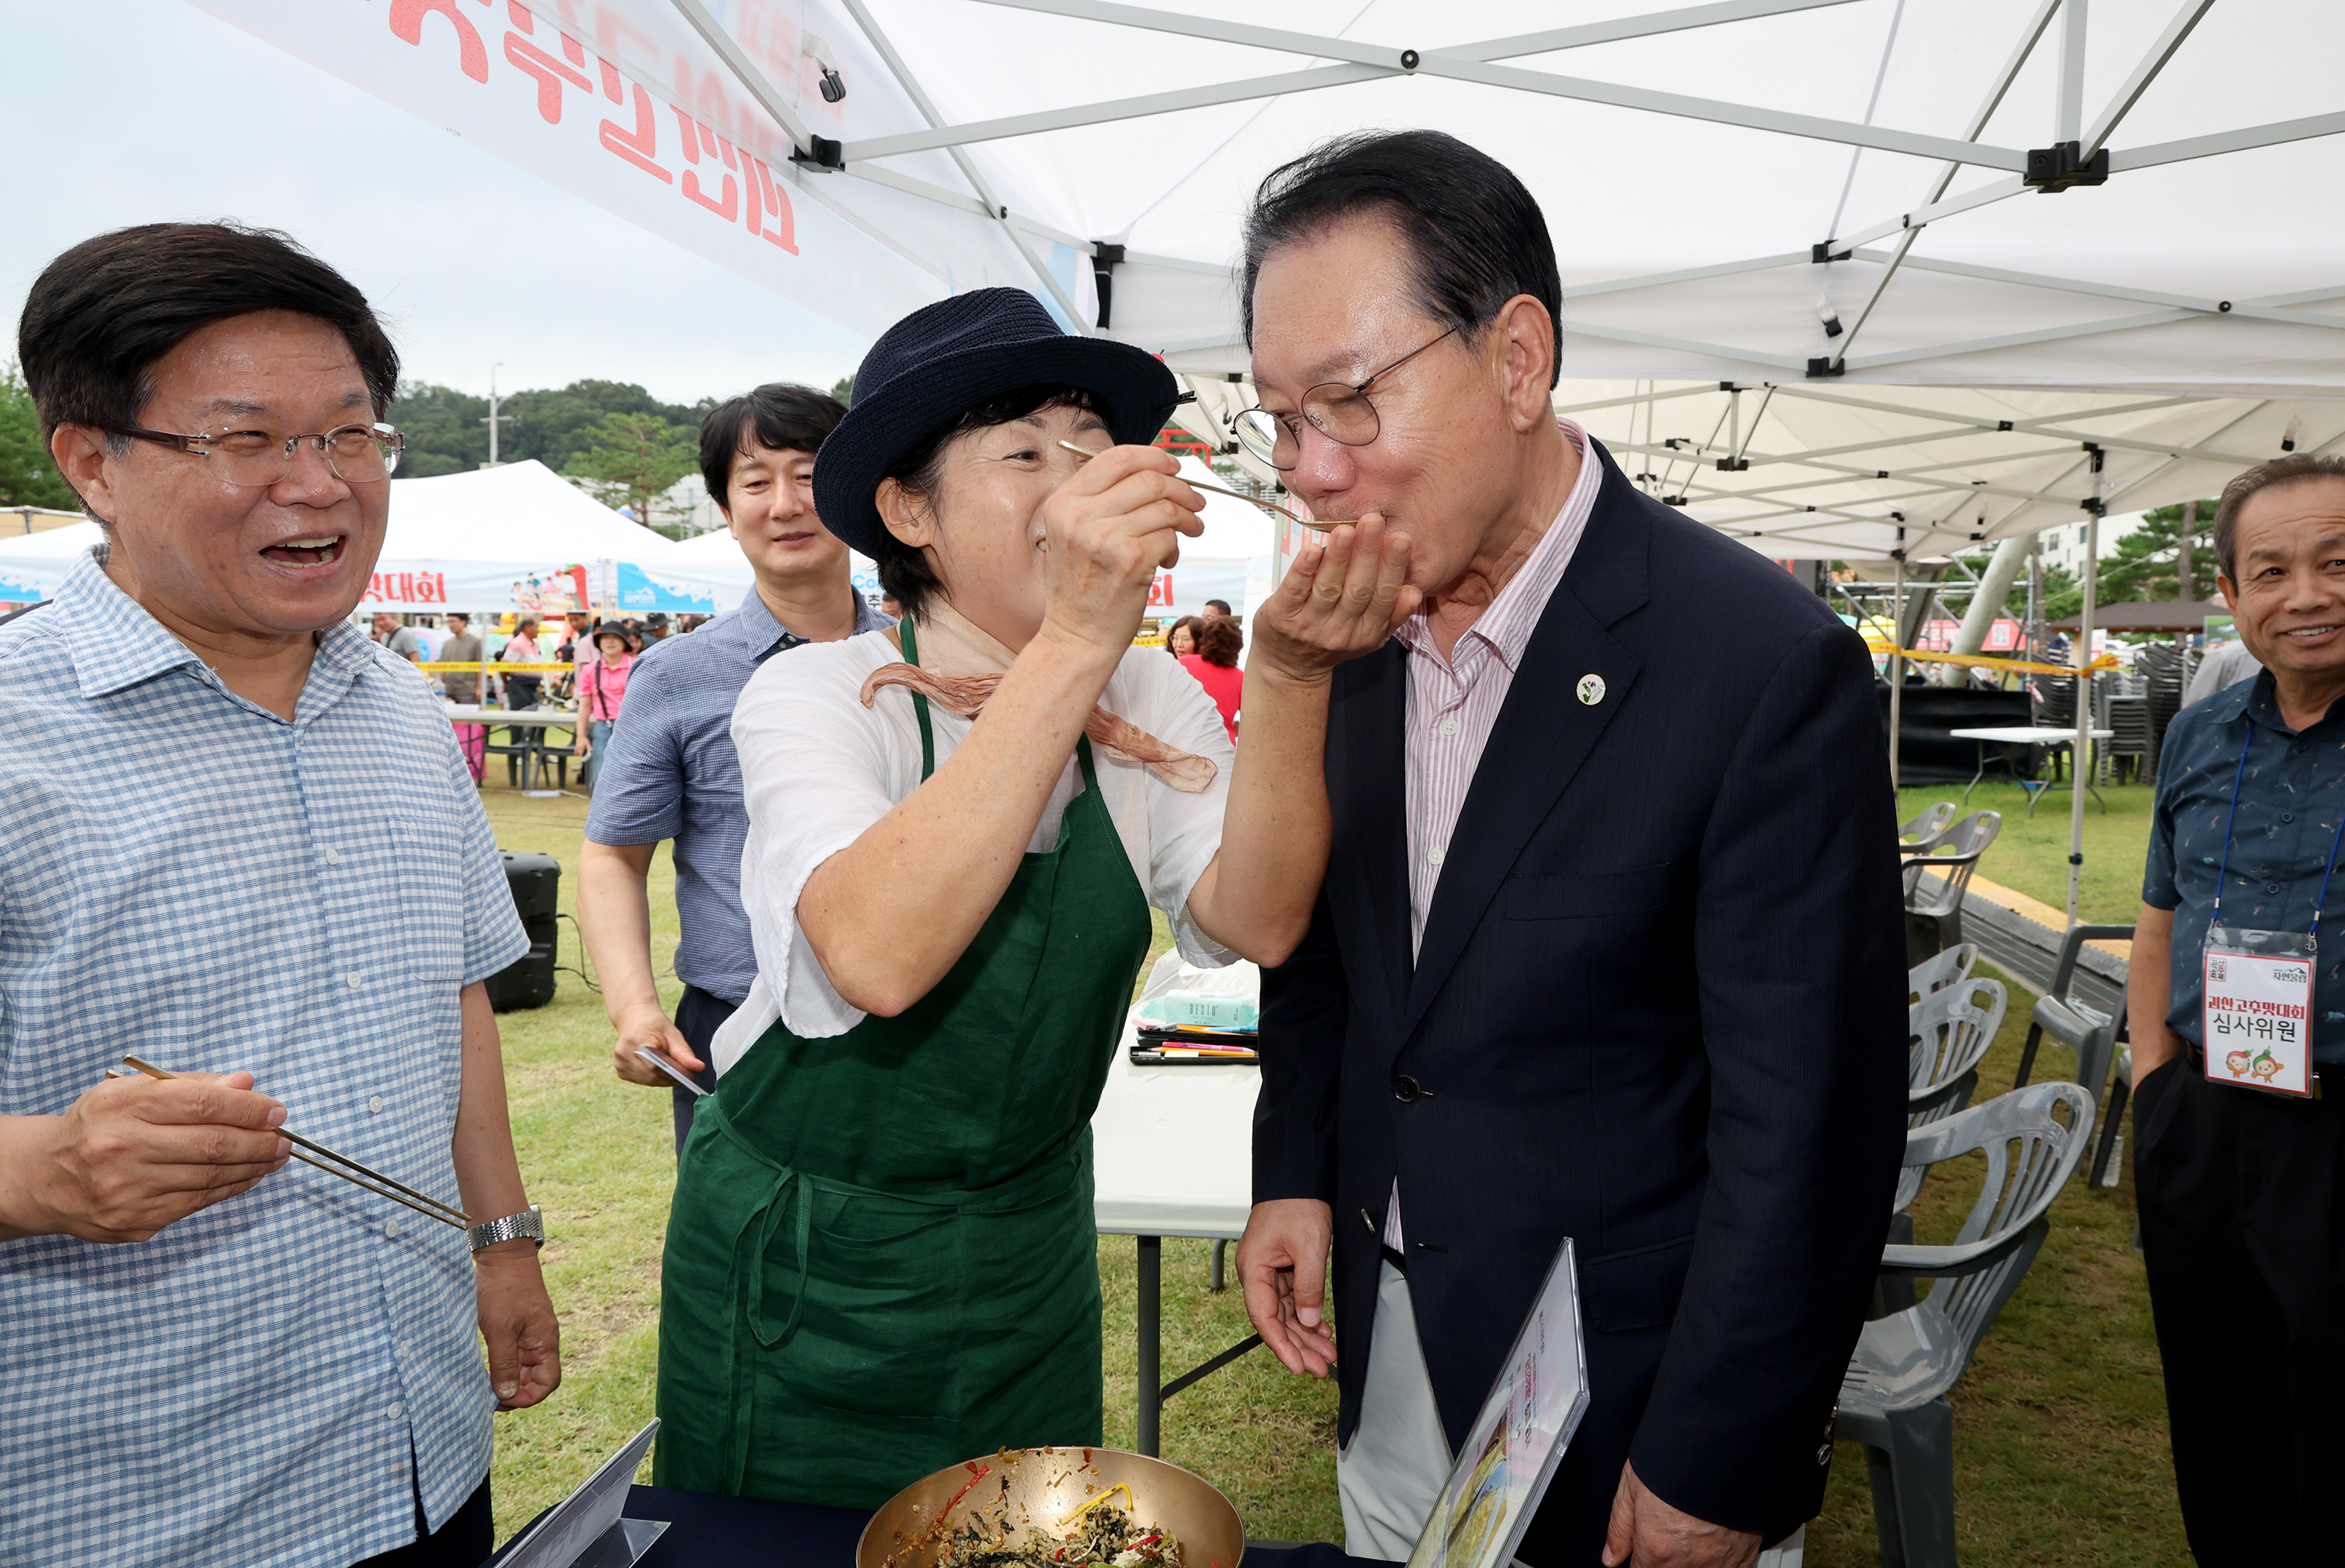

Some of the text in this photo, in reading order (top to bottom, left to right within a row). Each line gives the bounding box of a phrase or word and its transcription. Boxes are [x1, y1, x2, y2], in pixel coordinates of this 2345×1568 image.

[1190, 1004, 1216, 1016] BESTO
[2208, 997, 2305, 1019] 괴산고추맛대회
[2213, 1013, 2295, 1043] 심사위원
